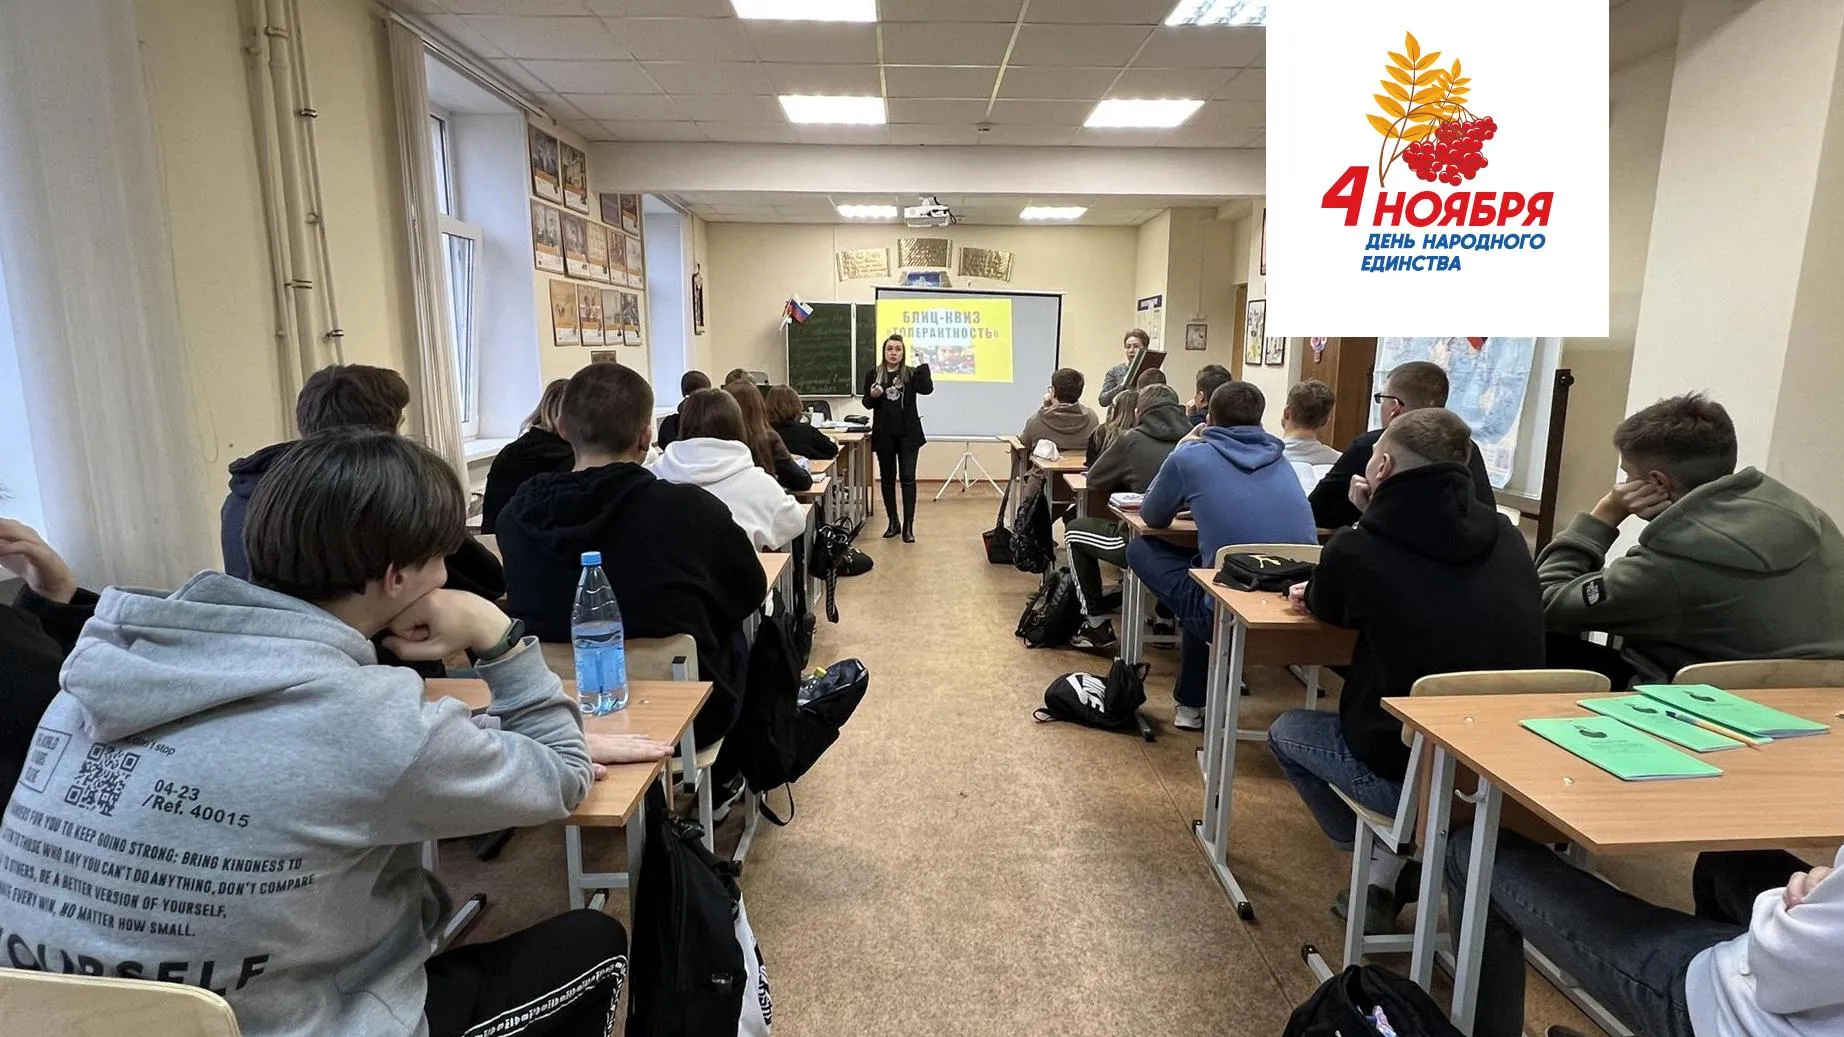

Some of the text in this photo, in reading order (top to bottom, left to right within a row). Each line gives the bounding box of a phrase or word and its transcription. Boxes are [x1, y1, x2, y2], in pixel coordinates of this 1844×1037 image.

[903, 310, 981, 325] БЛИЦ-КВИЗ
[141, 793, 250, 828] /Ref. 40015
[44, 814, 62, 832] YOU
[62, 820, 74, 837] TO
[74, 824, 97, 844] KEEP
[97, 831, 128, 854] GOING
[129, 841, 179, 864] STRONG:
[181, 851, 218, 870] BRING
[222, 857, 285, 873] KINDNESS
[288, 858, 303, 871] TO
[42, 841, 62, 861] WHO
[63, 848, 82, 868] SAY
[82, 855, 102, 873] YOU
[101, 861, 133, 881] CAN'T
[133, 868, 150, 885] DO
[150, 871, 216, 897] ANYTHING,
[218, 881, 257, 896] DON'T
[259, 873, 316, 895] COMPARE
[39, 868, 52, 885] BE
[52, 872, 60, 887] A
[61, 874, 93, 898] BETTER
[95, 885, 141, 909] VERSION
[142, 896, 160, 911] OF
[59, 901, 77, 918] NO
[77, 905, 115, 930] MATTER
[118, 917, 146, 933] HOW
[149, 922, 196, 937] SMALL.
